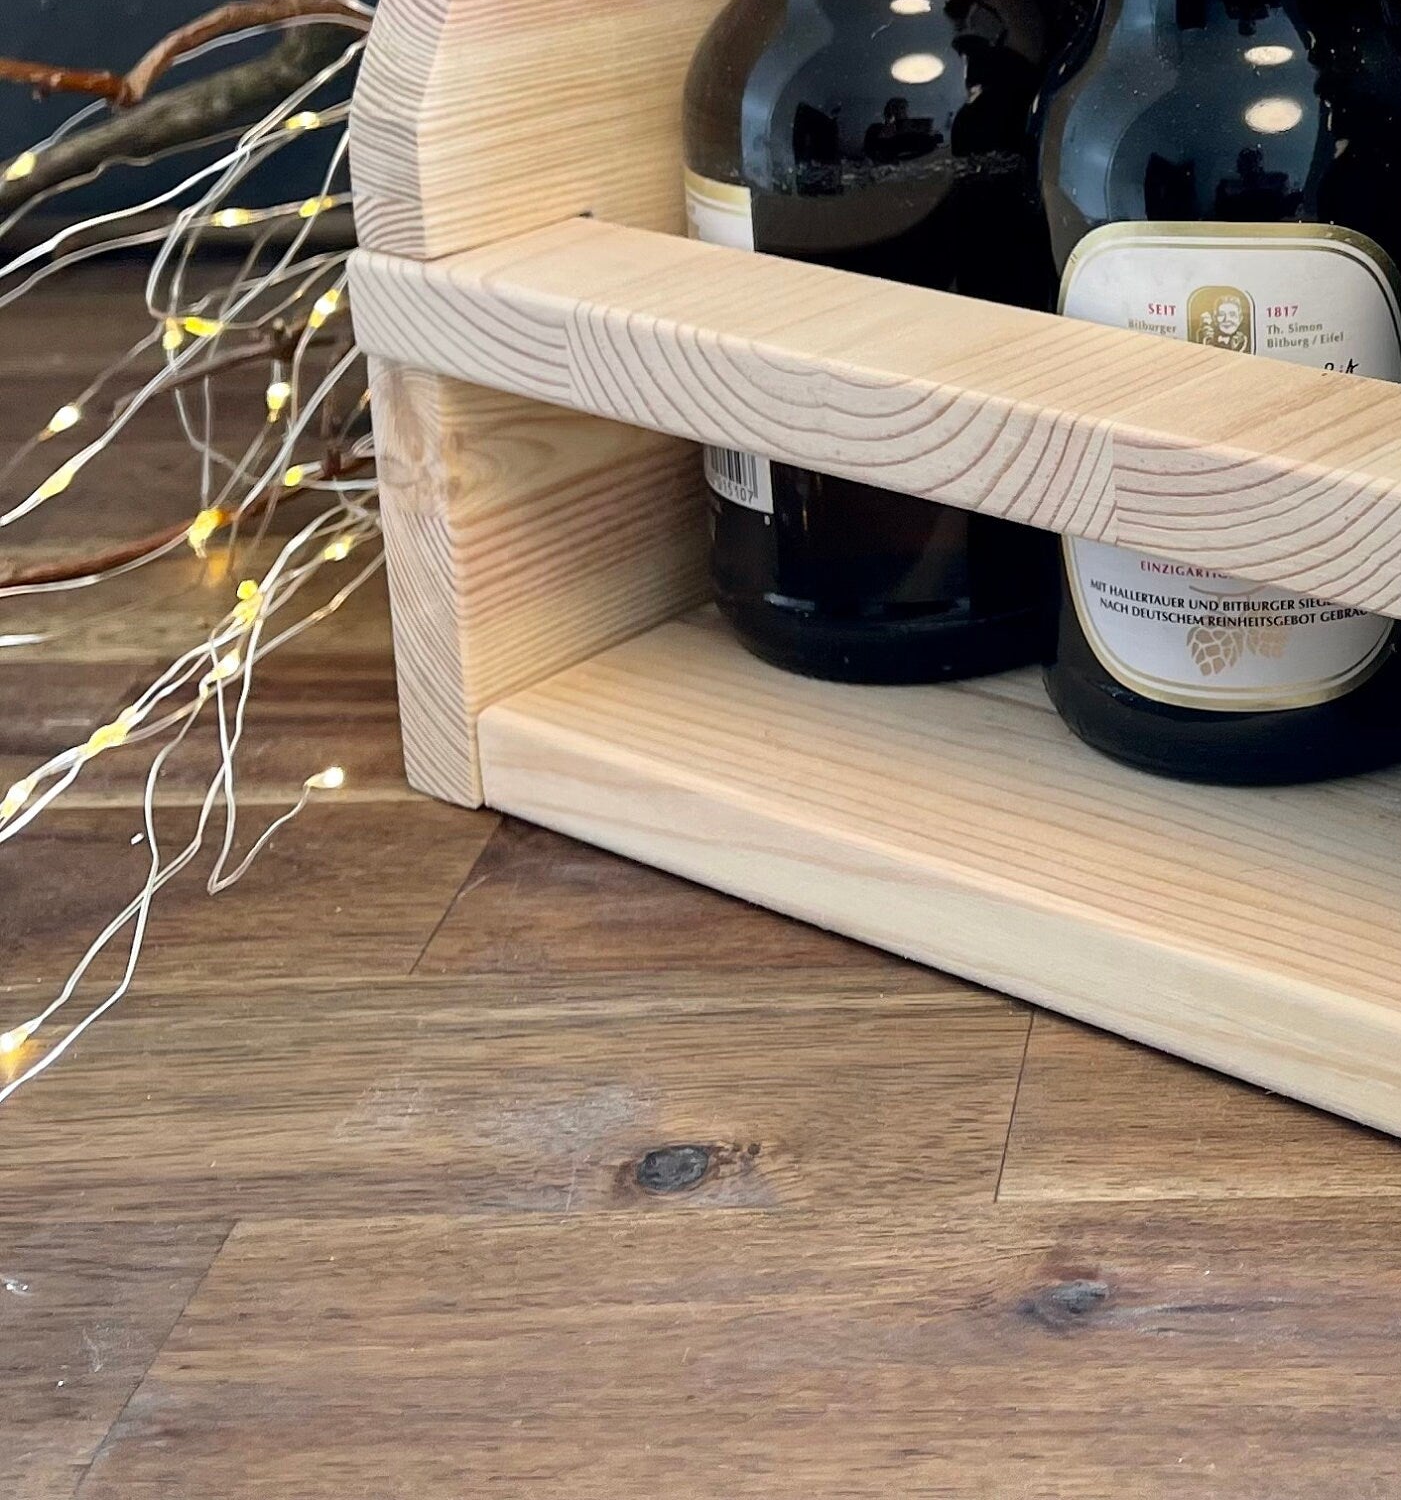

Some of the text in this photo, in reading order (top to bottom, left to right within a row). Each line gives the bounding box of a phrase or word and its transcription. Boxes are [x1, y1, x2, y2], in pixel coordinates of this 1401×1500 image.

[1147, 303, 1298, 318] SEIT 1817
[1127, 319, 1177, 335] Bitburger
[1288, 323, 1323, 334] Simon
[1267, 337, 1310, 348] Bitburg
[1320, 332, 1344, 345] Eifel
[1090, 579, 1107, 593] MIT
[1109, 584, 1185, 609] HALLERTAUER
[1188, 599, 1219, 612] UND
[1222, 599, 1295, 612] BITBURGER
[1100, 597, 1129, 615] NACH
[1131, 605, 1204, 626] DEUTSCHEM
[1207, 612, 1317, 629] REINHEITSGEBOT
